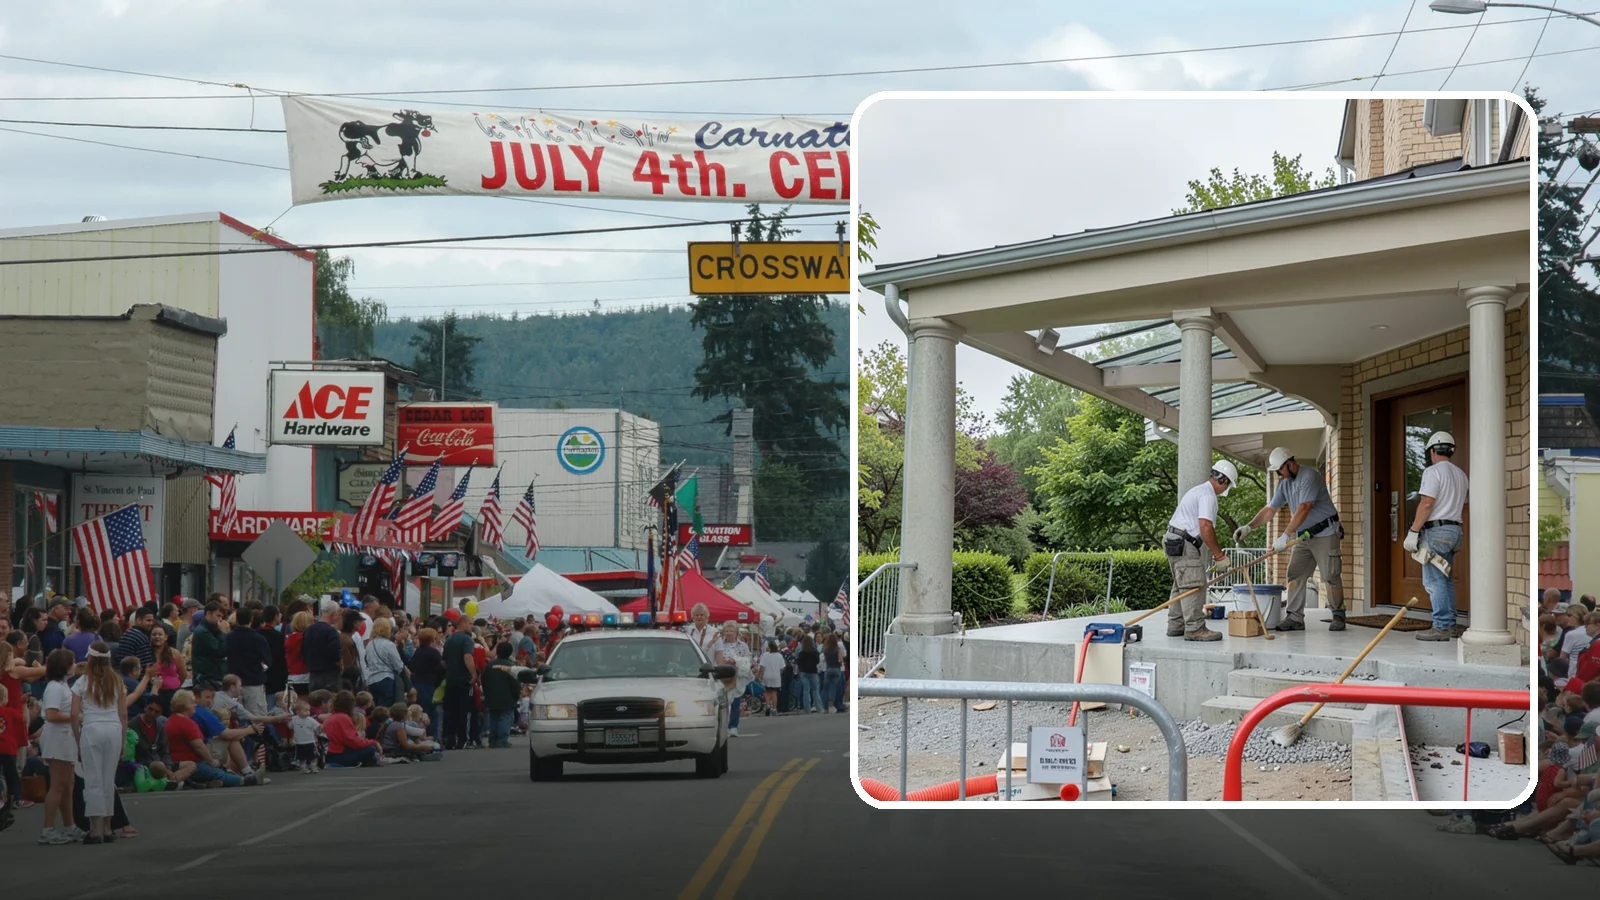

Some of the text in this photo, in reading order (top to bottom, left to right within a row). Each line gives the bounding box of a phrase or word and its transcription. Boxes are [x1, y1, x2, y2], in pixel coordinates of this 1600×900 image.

[481, 141, 605, 192] JULY
[632, 150, 746, 198] 4th.
[697, 254, 849, 280] CROSSWA
[283, 380, 373, 420] ACE
[405, 409, 453, 422] CEDAR
[284, 420, 371, 436] Hardware
[416, 428, 477, 446] Coca-Cola
[353, 467, 384, 481] Simpl
[83, 485, 155, 495] St. Vincent de Paul
[212, 516, 331, 535] HARDARE
[688, 526, 741, 535] CRNATION
[699, 535, 730, 543] GLASS
